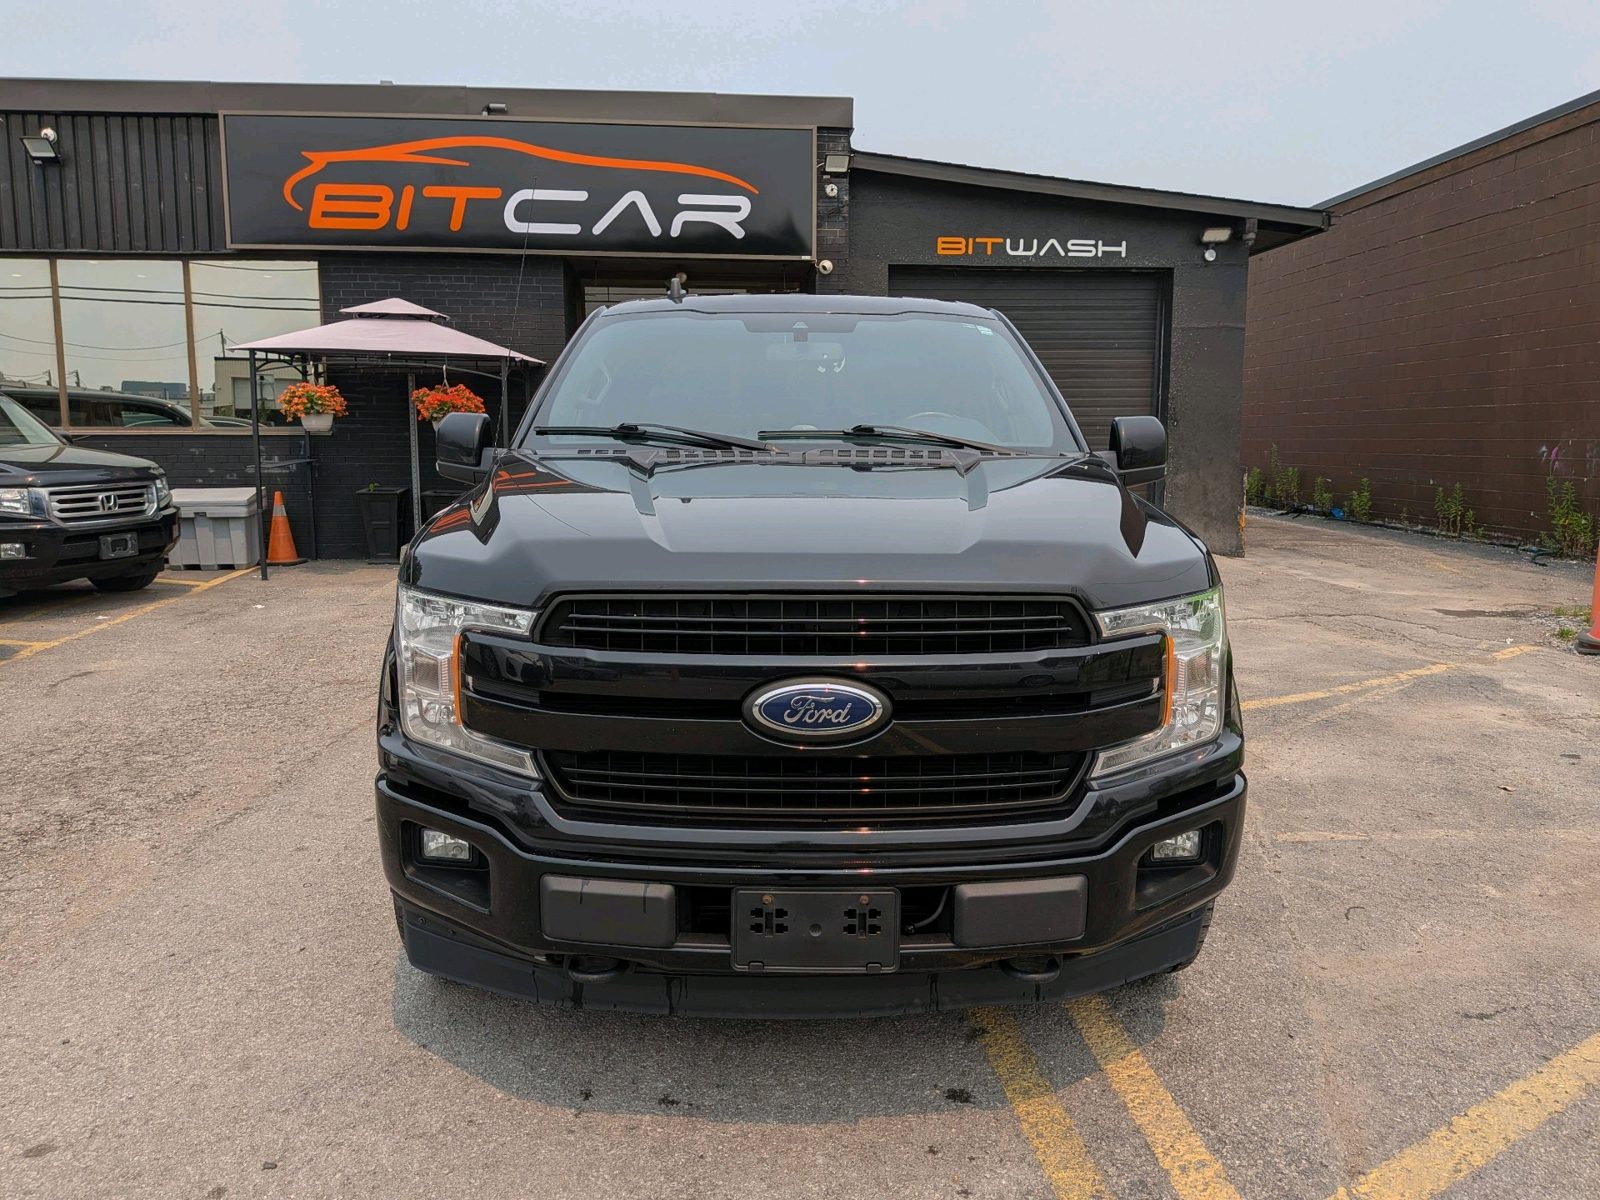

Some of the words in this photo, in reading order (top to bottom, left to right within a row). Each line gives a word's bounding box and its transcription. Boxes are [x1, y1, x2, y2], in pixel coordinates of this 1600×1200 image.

[307, 183, 752, 239] BITCAR
[936, 236, 1127, 258] BITWASH
[783, 695, 853, 724] Ford
